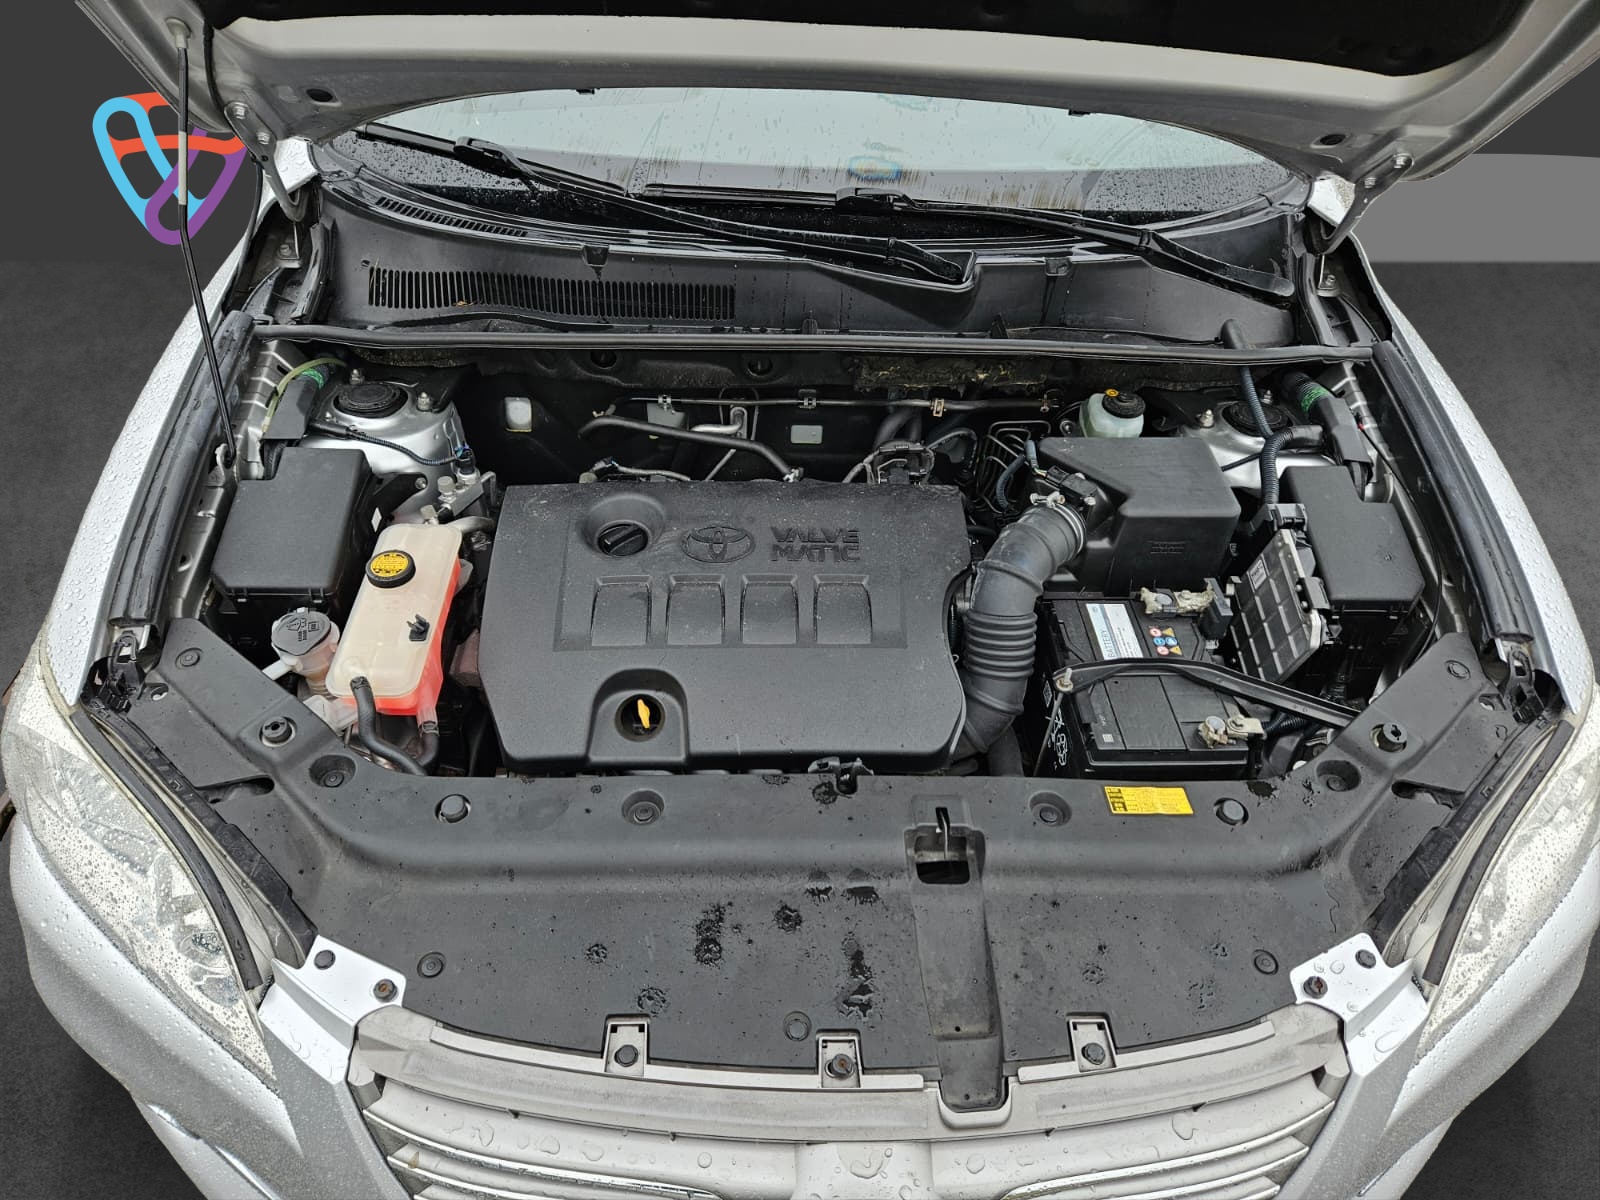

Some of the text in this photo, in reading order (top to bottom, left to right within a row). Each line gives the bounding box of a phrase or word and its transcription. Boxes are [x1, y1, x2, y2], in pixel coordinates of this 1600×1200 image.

[770, 526, 860, 543] VALVE
[770, 544, 861, 562] MATIC
[1101, 630, 1117, 658] BATTERY
